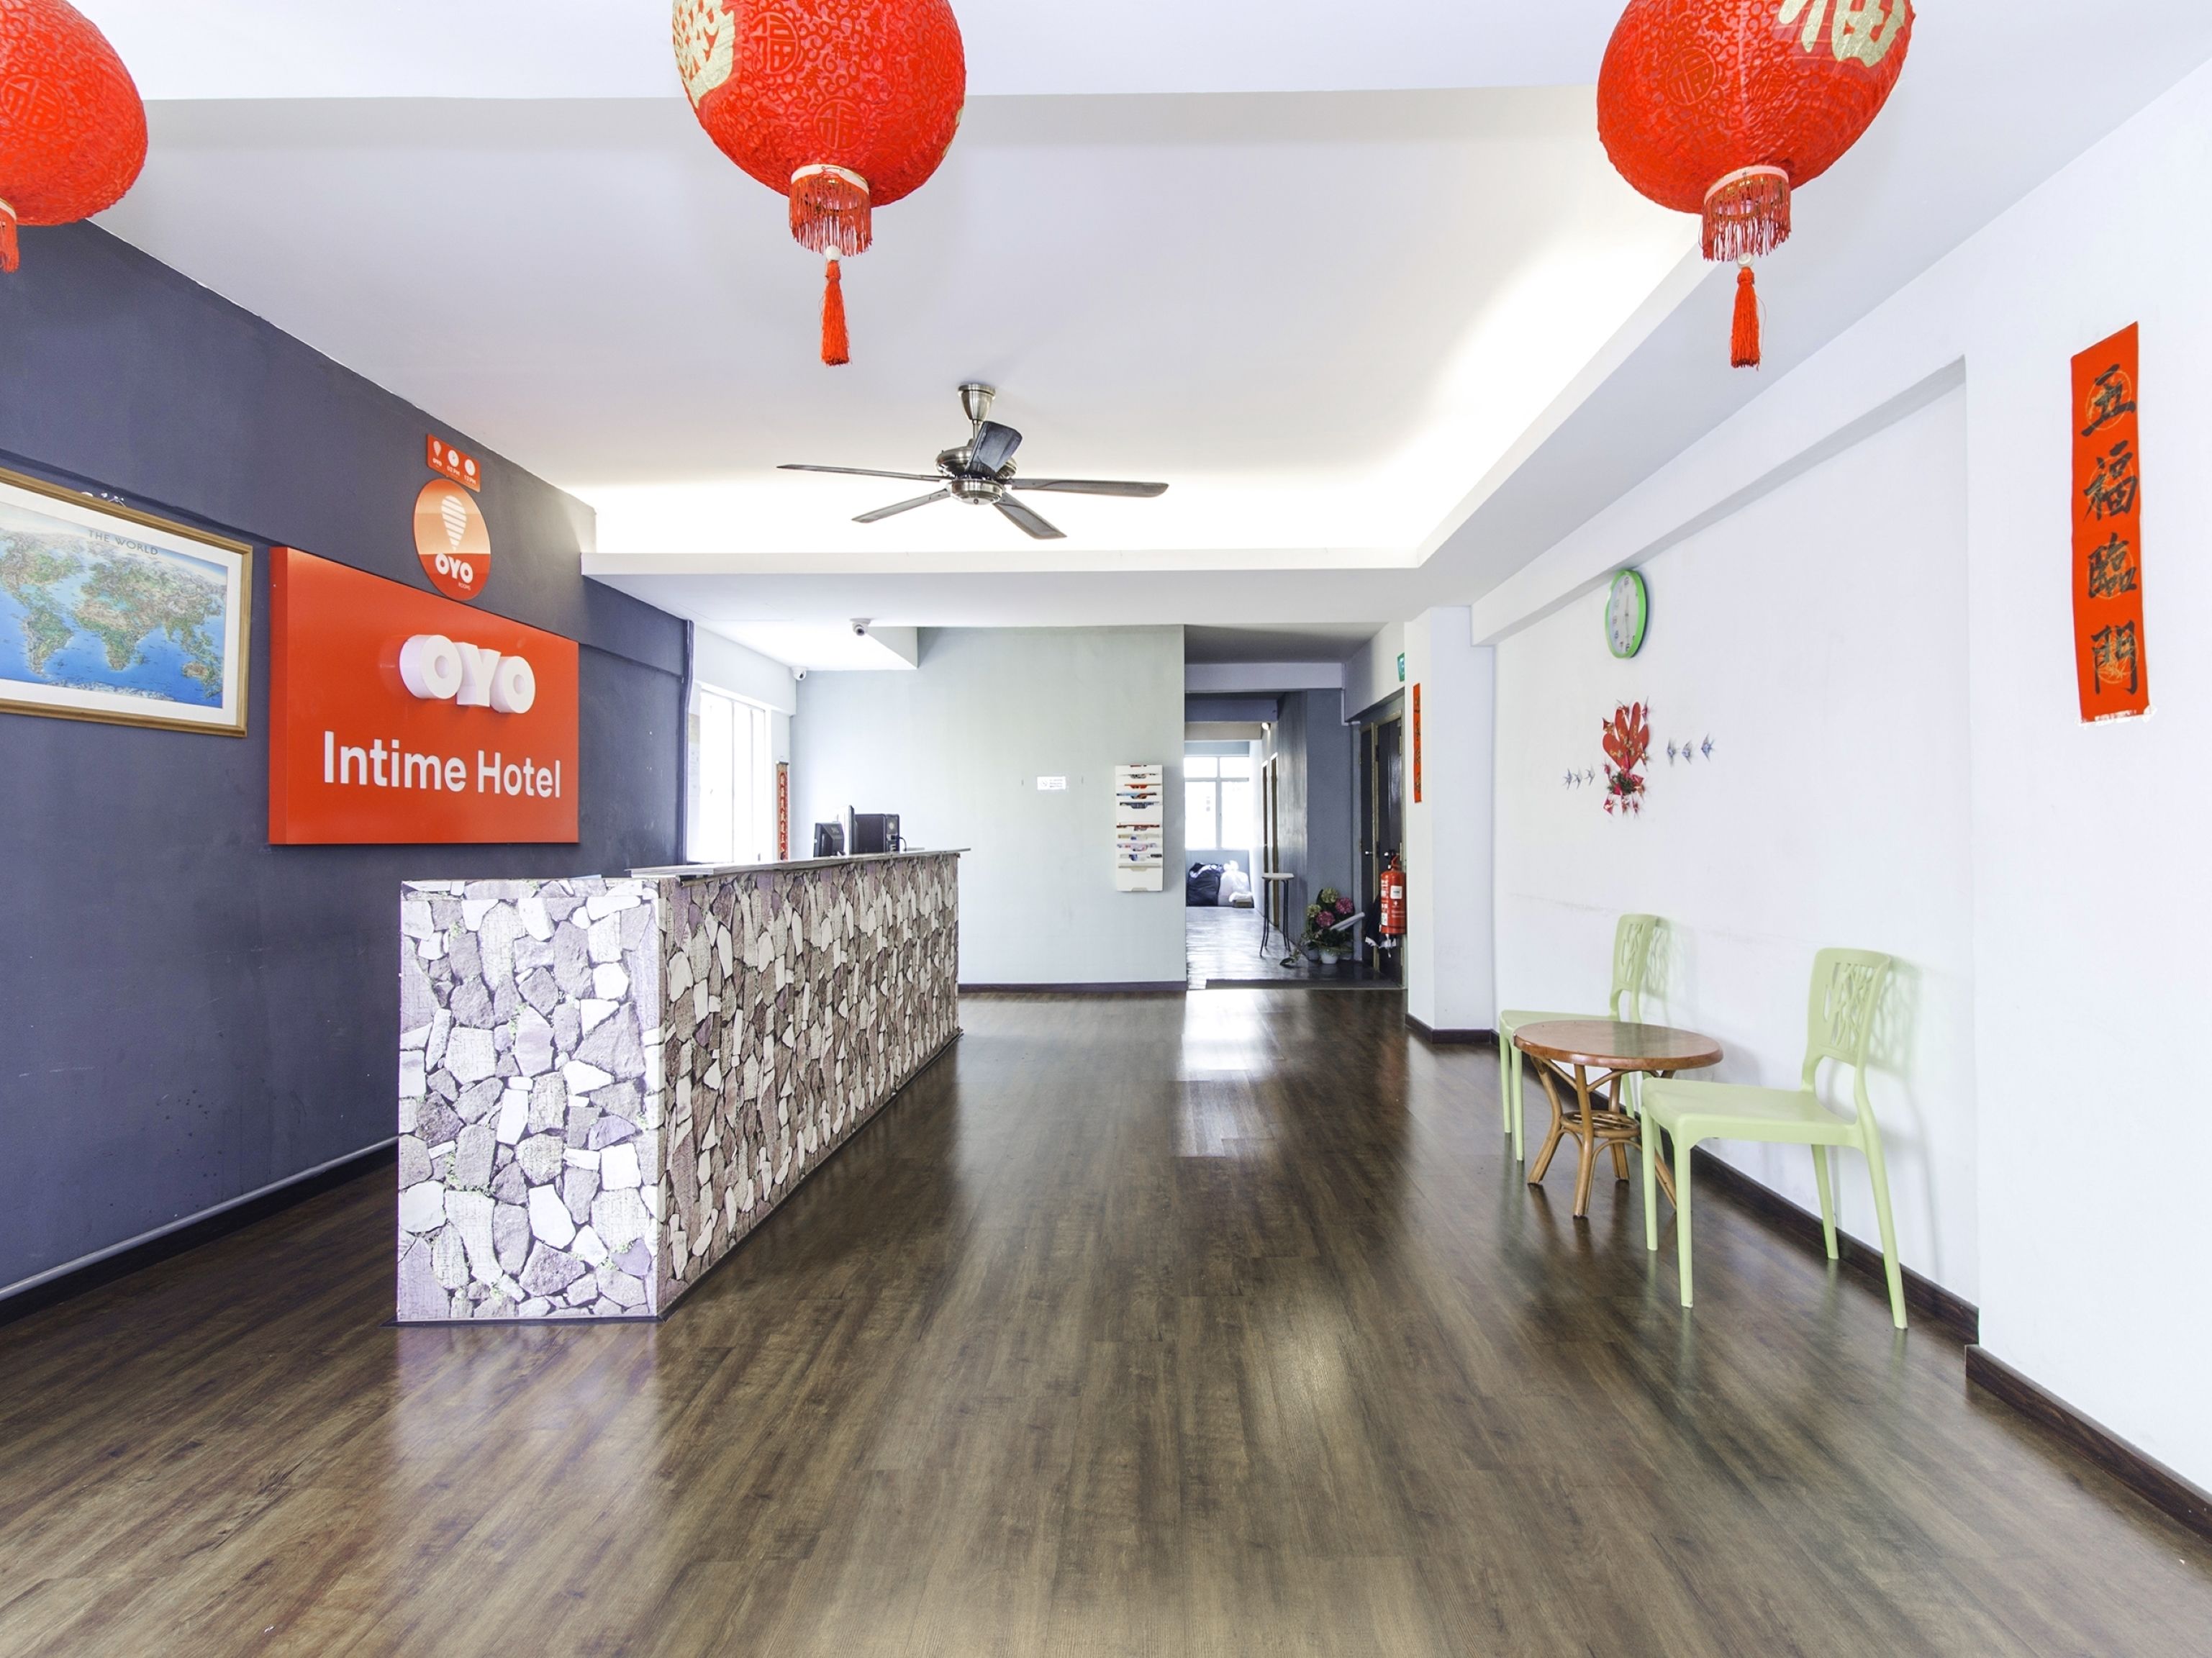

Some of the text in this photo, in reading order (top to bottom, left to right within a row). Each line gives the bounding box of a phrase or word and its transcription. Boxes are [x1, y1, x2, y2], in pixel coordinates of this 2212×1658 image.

[89, 530, 158, 556] THE WORLD
[2081, 363, 2137, 695] 五福臨門
[435, 553, 473, 584] OYO
[399, 634, 535, 714] OYO
[325, 730, 561, 798] Intime Hotel
